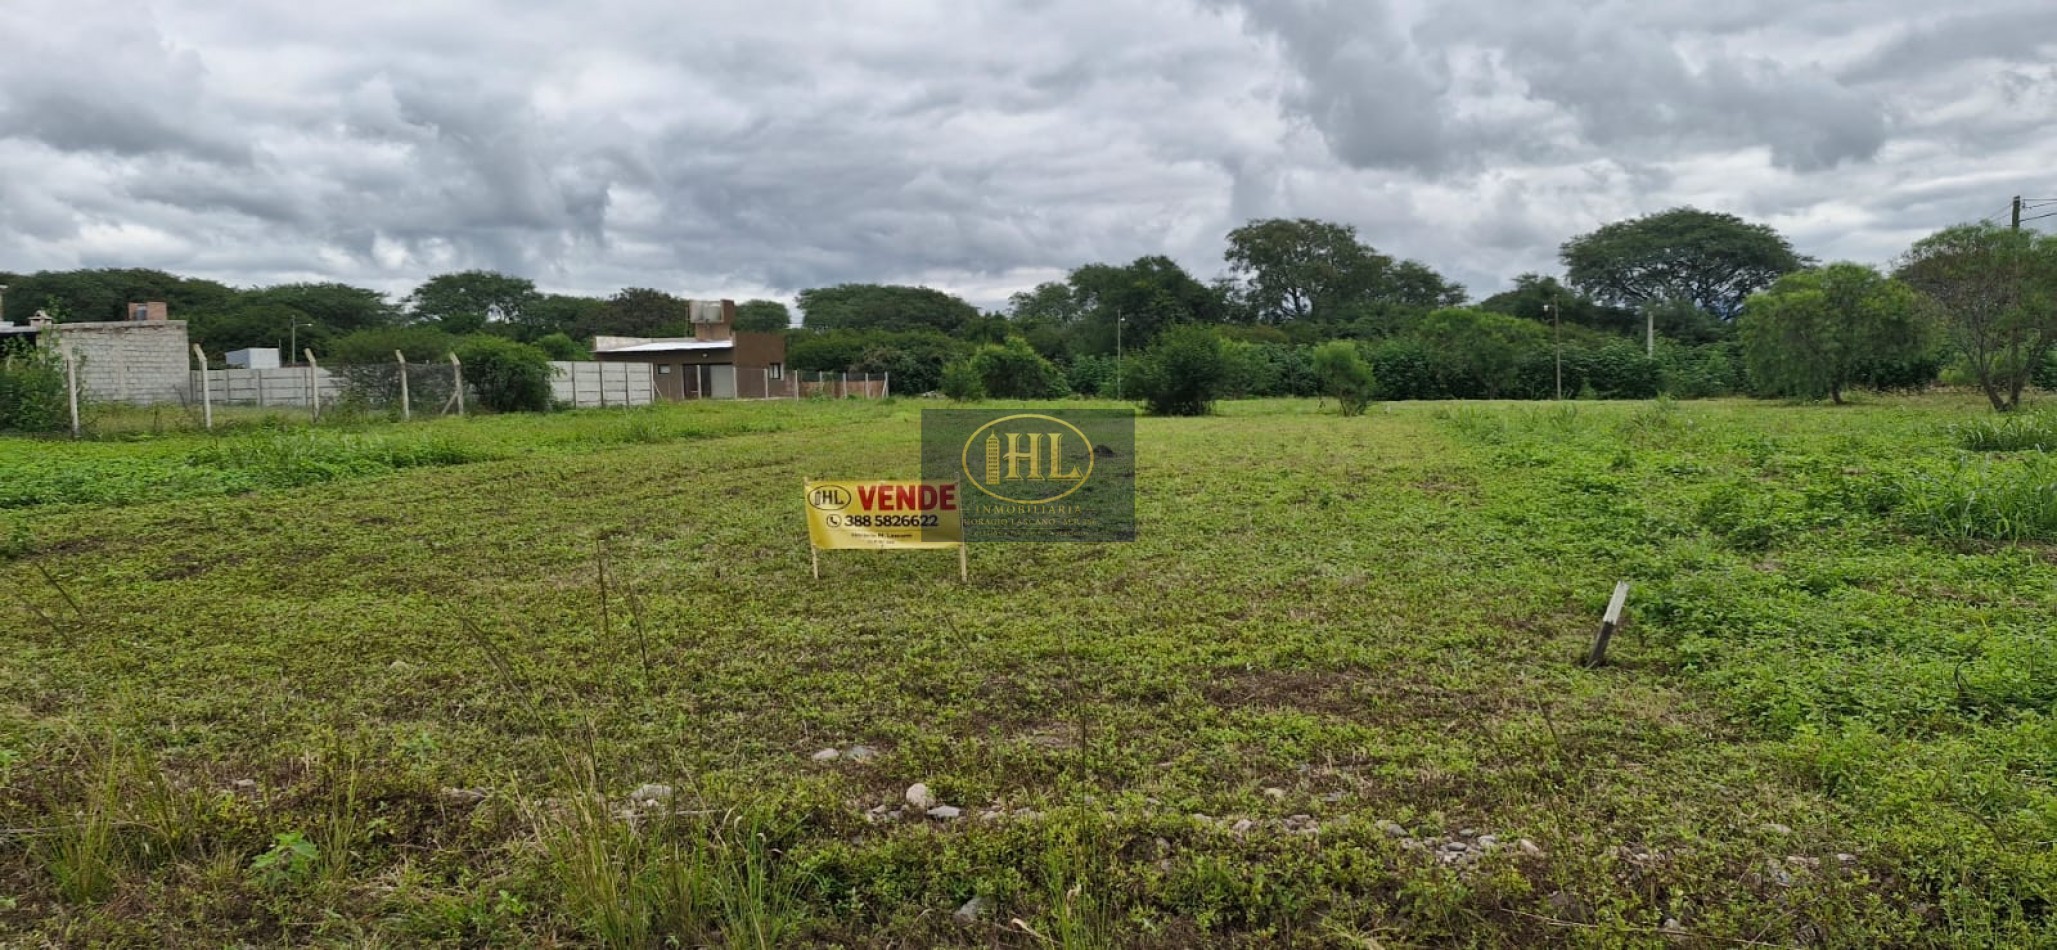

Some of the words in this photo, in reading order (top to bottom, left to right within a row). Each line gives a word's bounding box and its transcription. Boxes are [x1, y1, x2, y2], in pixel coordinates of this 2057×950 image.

[822, 490, 844, 505] HL
[857, 484, 957, 511] VENDE
[845, 514, 871, 527] 388
[874, 514, 939, 527] 5826622
